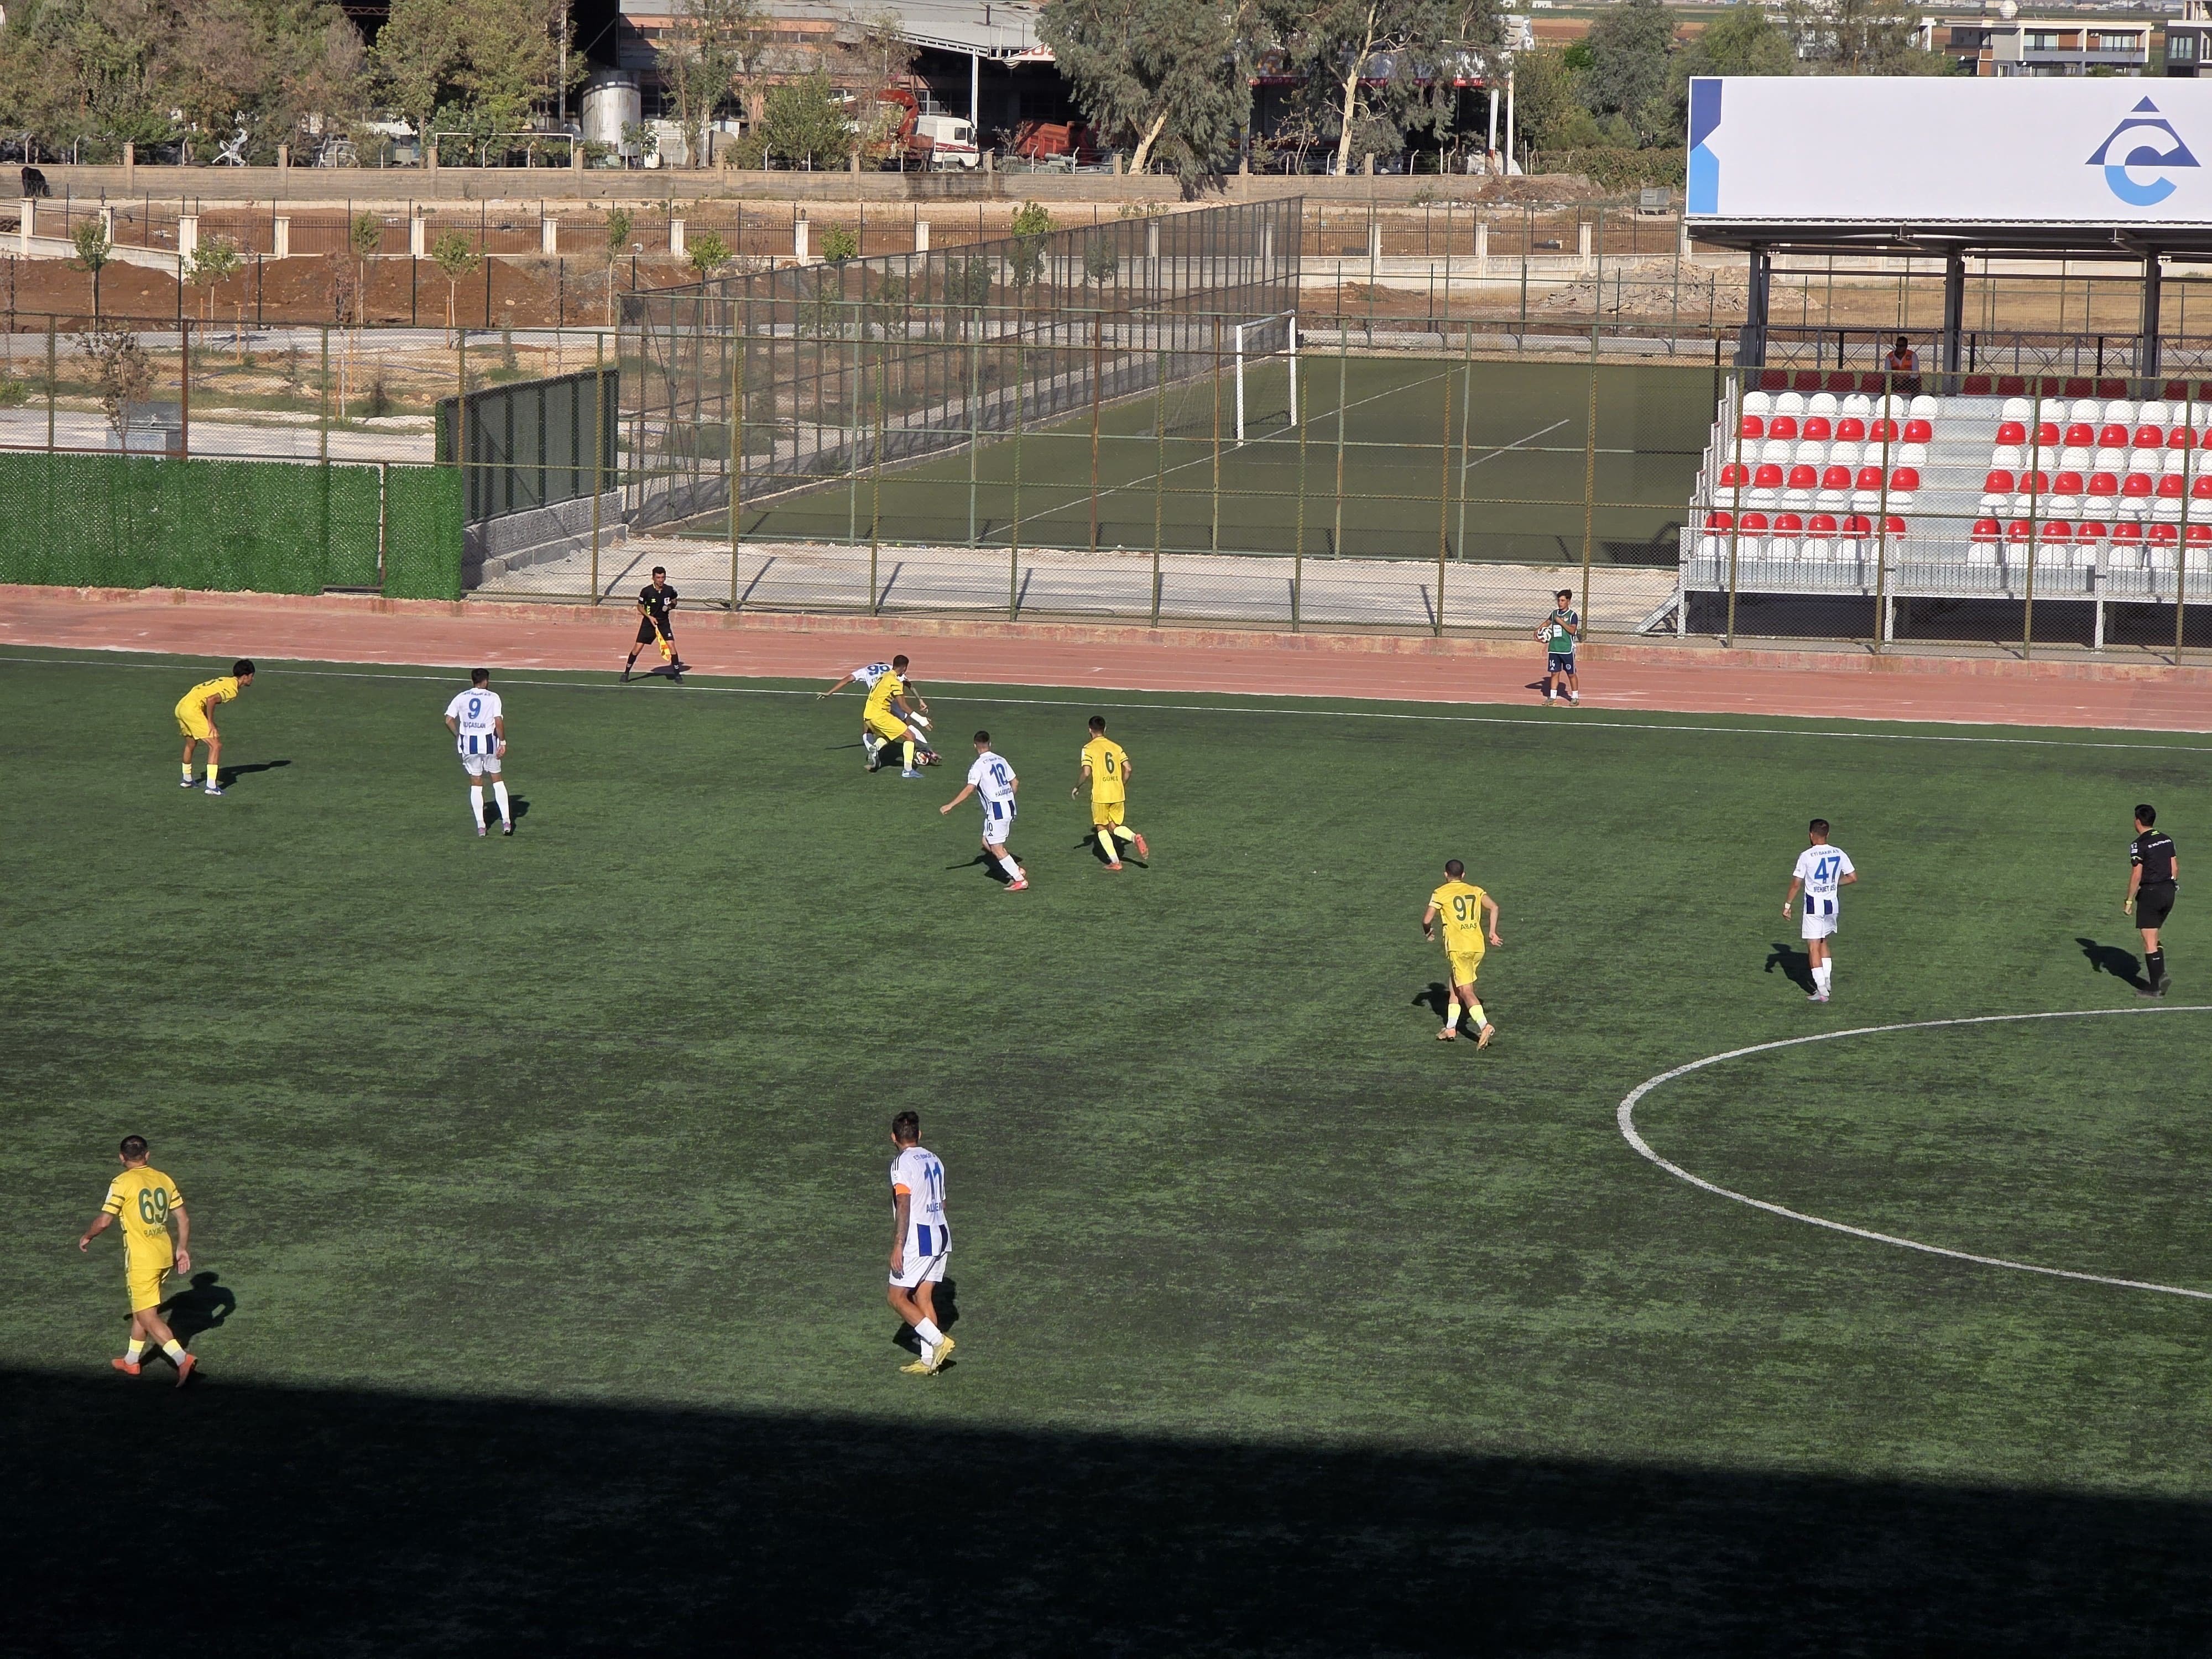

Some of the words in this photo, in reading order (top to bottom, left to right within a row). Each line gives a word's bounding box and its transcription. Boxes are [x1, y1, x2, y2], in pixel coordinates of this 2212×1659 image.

[867, 665, 890, 676] 99
[468, 698, 481, 719] 9
[989, 763, 1009, 787] 10
[1105, 752, 1115, 774] 6
[1814, 855, 1840, 884] 47
[1453, 894, 1476, 921] 97
[924, 1161, 942, 1200] 11
[138, 1187, 168, 1224] 69
